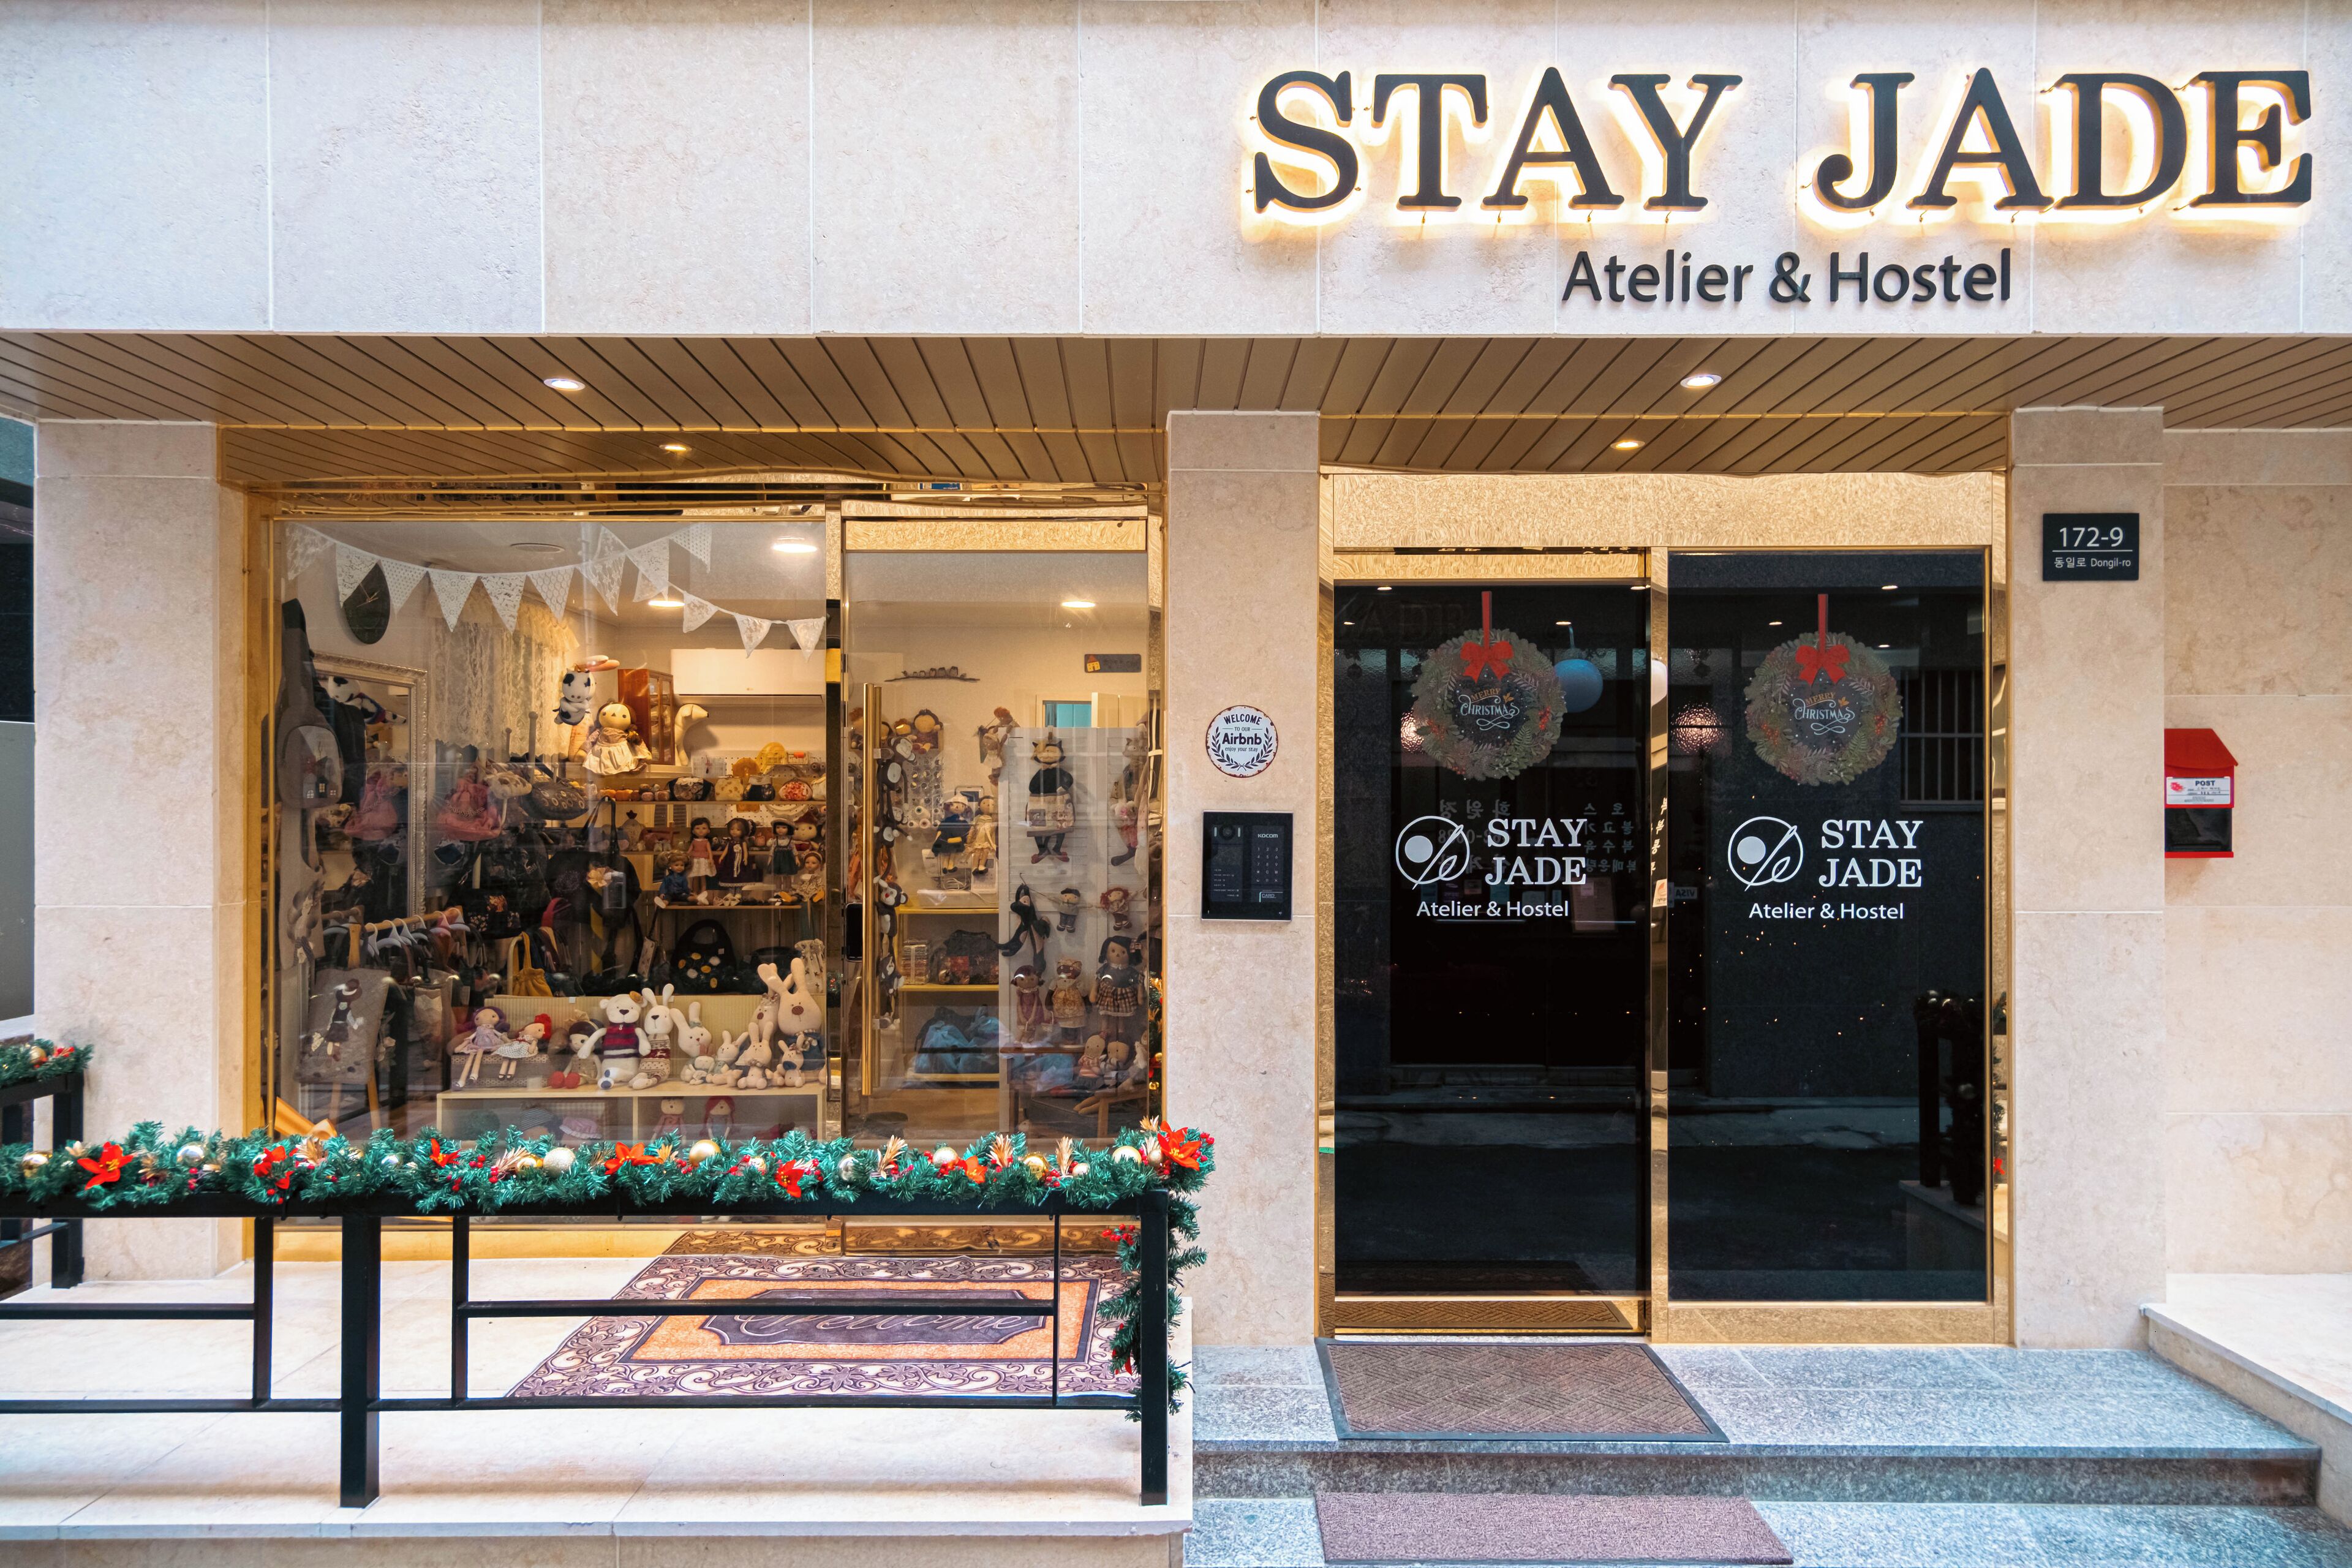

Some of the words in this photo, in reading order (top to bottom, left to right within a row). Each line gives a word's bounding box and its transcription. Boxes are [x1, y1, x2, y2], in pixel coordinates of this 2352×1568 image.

[1253, 67, 1743, 212] STAY
[1815, 67, 2313, 212] JADE
[1562, 250, 1754, 303] Atelier
[1769, 252, 1811, 303] &
[1829, 248, 2011, 303] Hostel
[2059, 527, 2124, 547] 172-9
[2054, 557, 2087, 568] 동일로
[2090, 557, 2132, 569] Dongil-ro
[1471, 688, 1501, 701] MERRY
[1805, 692, 1836, 706] MERRY
[1459, 697, 1520, 718] CHRISTMAS
[1793, 701, 1855, 723] CHRISTMAS
[1223, 714, 1262, 725] WELCOME
[1222, 733, 1262, 745] Airbnb
[1487, 818, 1588, 848] STAY
[1822, 819, 1924, 849] STAY
[1485, 856, 1587, 886] JADE
[1819, 858, 1922, 888] JADE
[1416, 900, 1482, 916] Atelier
[1487, 901, 1501, 916] &
[1507, 900, 1568, 916] Hostel
[1749, 903, 1815, 919] Atelier
[1820, 903, 1834, 919] &
[1841, 903, 1904, 920] Hostel
